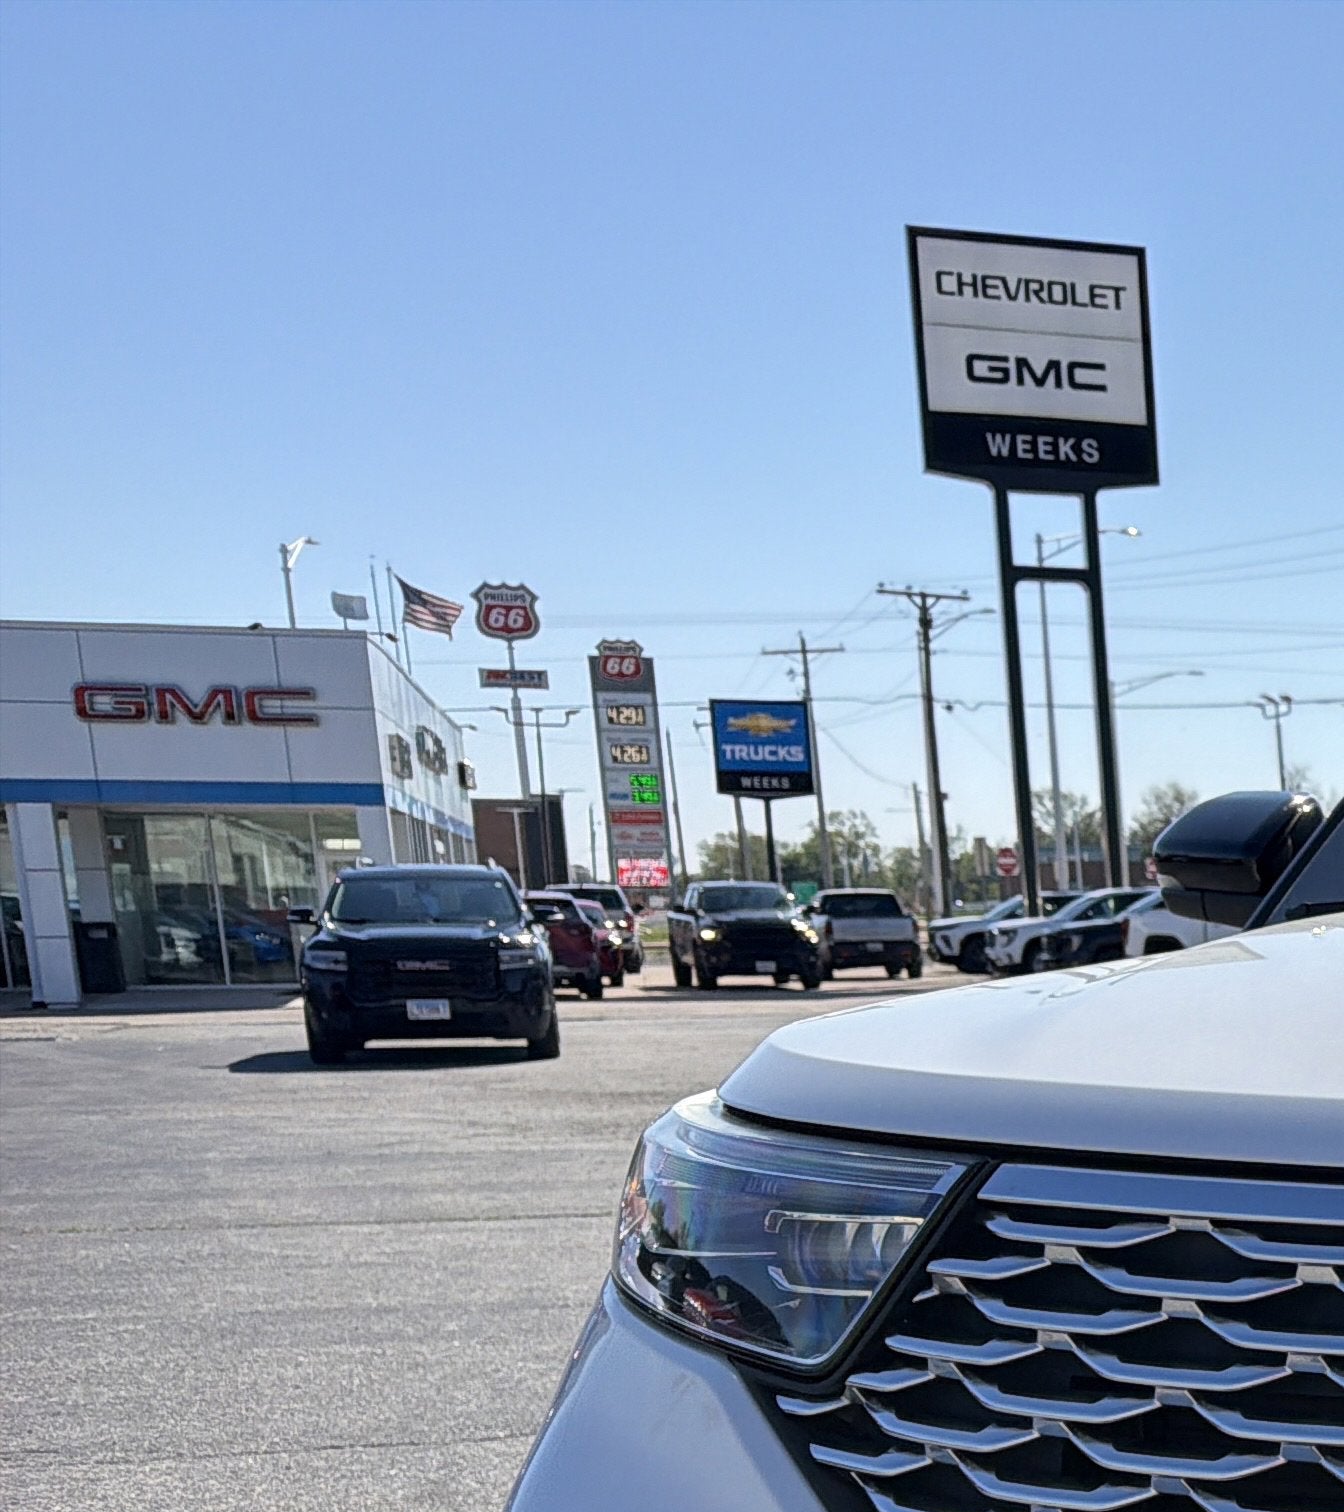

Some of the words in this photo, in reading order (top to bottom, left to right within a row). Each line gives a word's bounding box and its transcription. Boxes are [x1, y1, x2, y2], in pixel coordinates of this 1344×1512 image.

[935, 270, 1127, 310] CHEVROLET
[965, 353, 1108, 392] GMC
[985, 431, 1100, 464] WEEKS
[483, 591, 527, 603] PHILLIPS
[488, 607, 525, 629] 66
[606, 657, 637, 675] 66
[73, 683, 319, 726] GMC
[721, 744, 805, 762] TRUCKS
[741, 776, 791, 790] WEEKS
